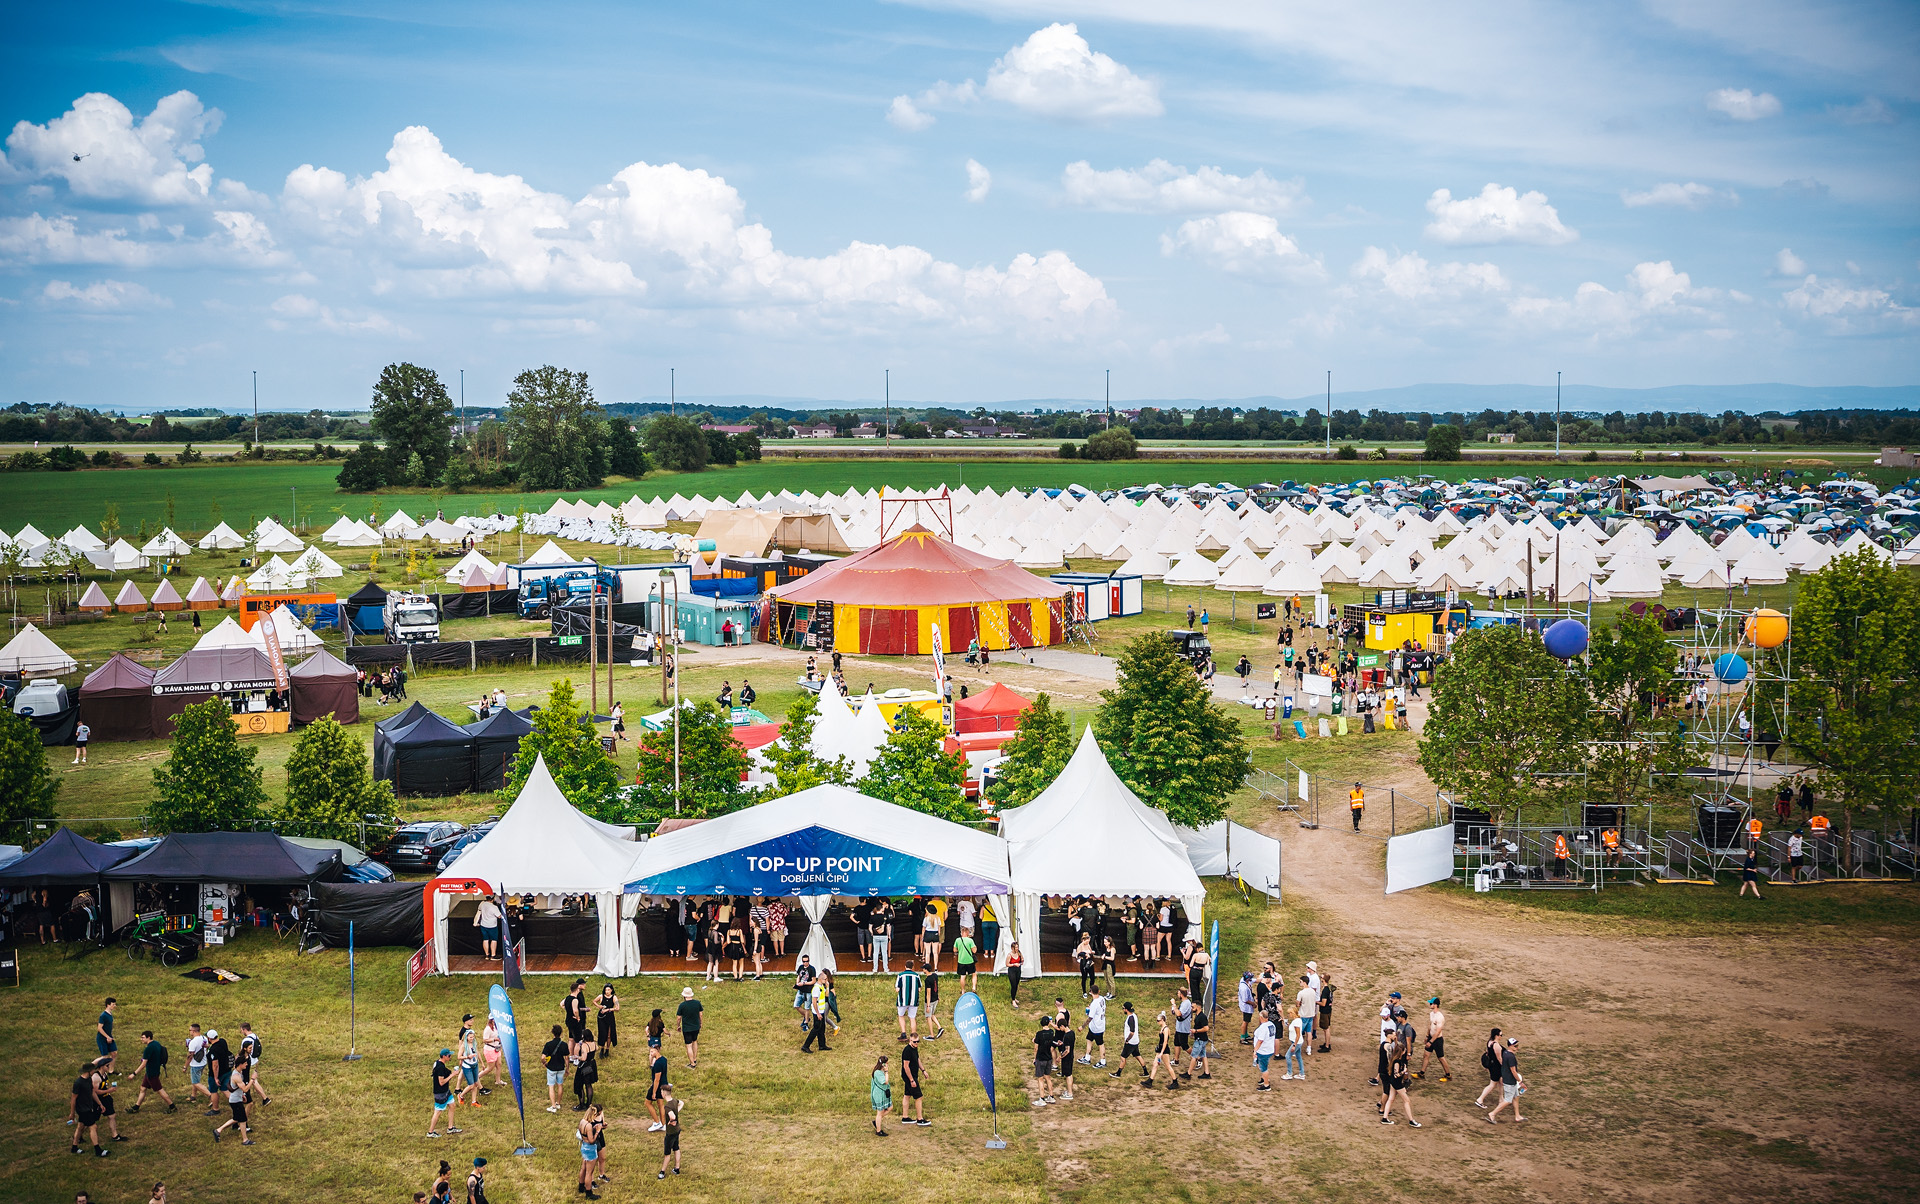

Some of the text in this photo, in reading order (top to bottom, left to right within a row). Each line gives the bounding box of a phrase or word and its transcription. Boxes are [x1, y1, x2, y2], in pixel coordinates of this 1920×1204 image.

[164, 685, 182, 693] KÁVA
[746, 856, 884, 872] TOP-UP POINT
[780, 872, 849, 883] DOBÍJENÍ ČIPŮ
